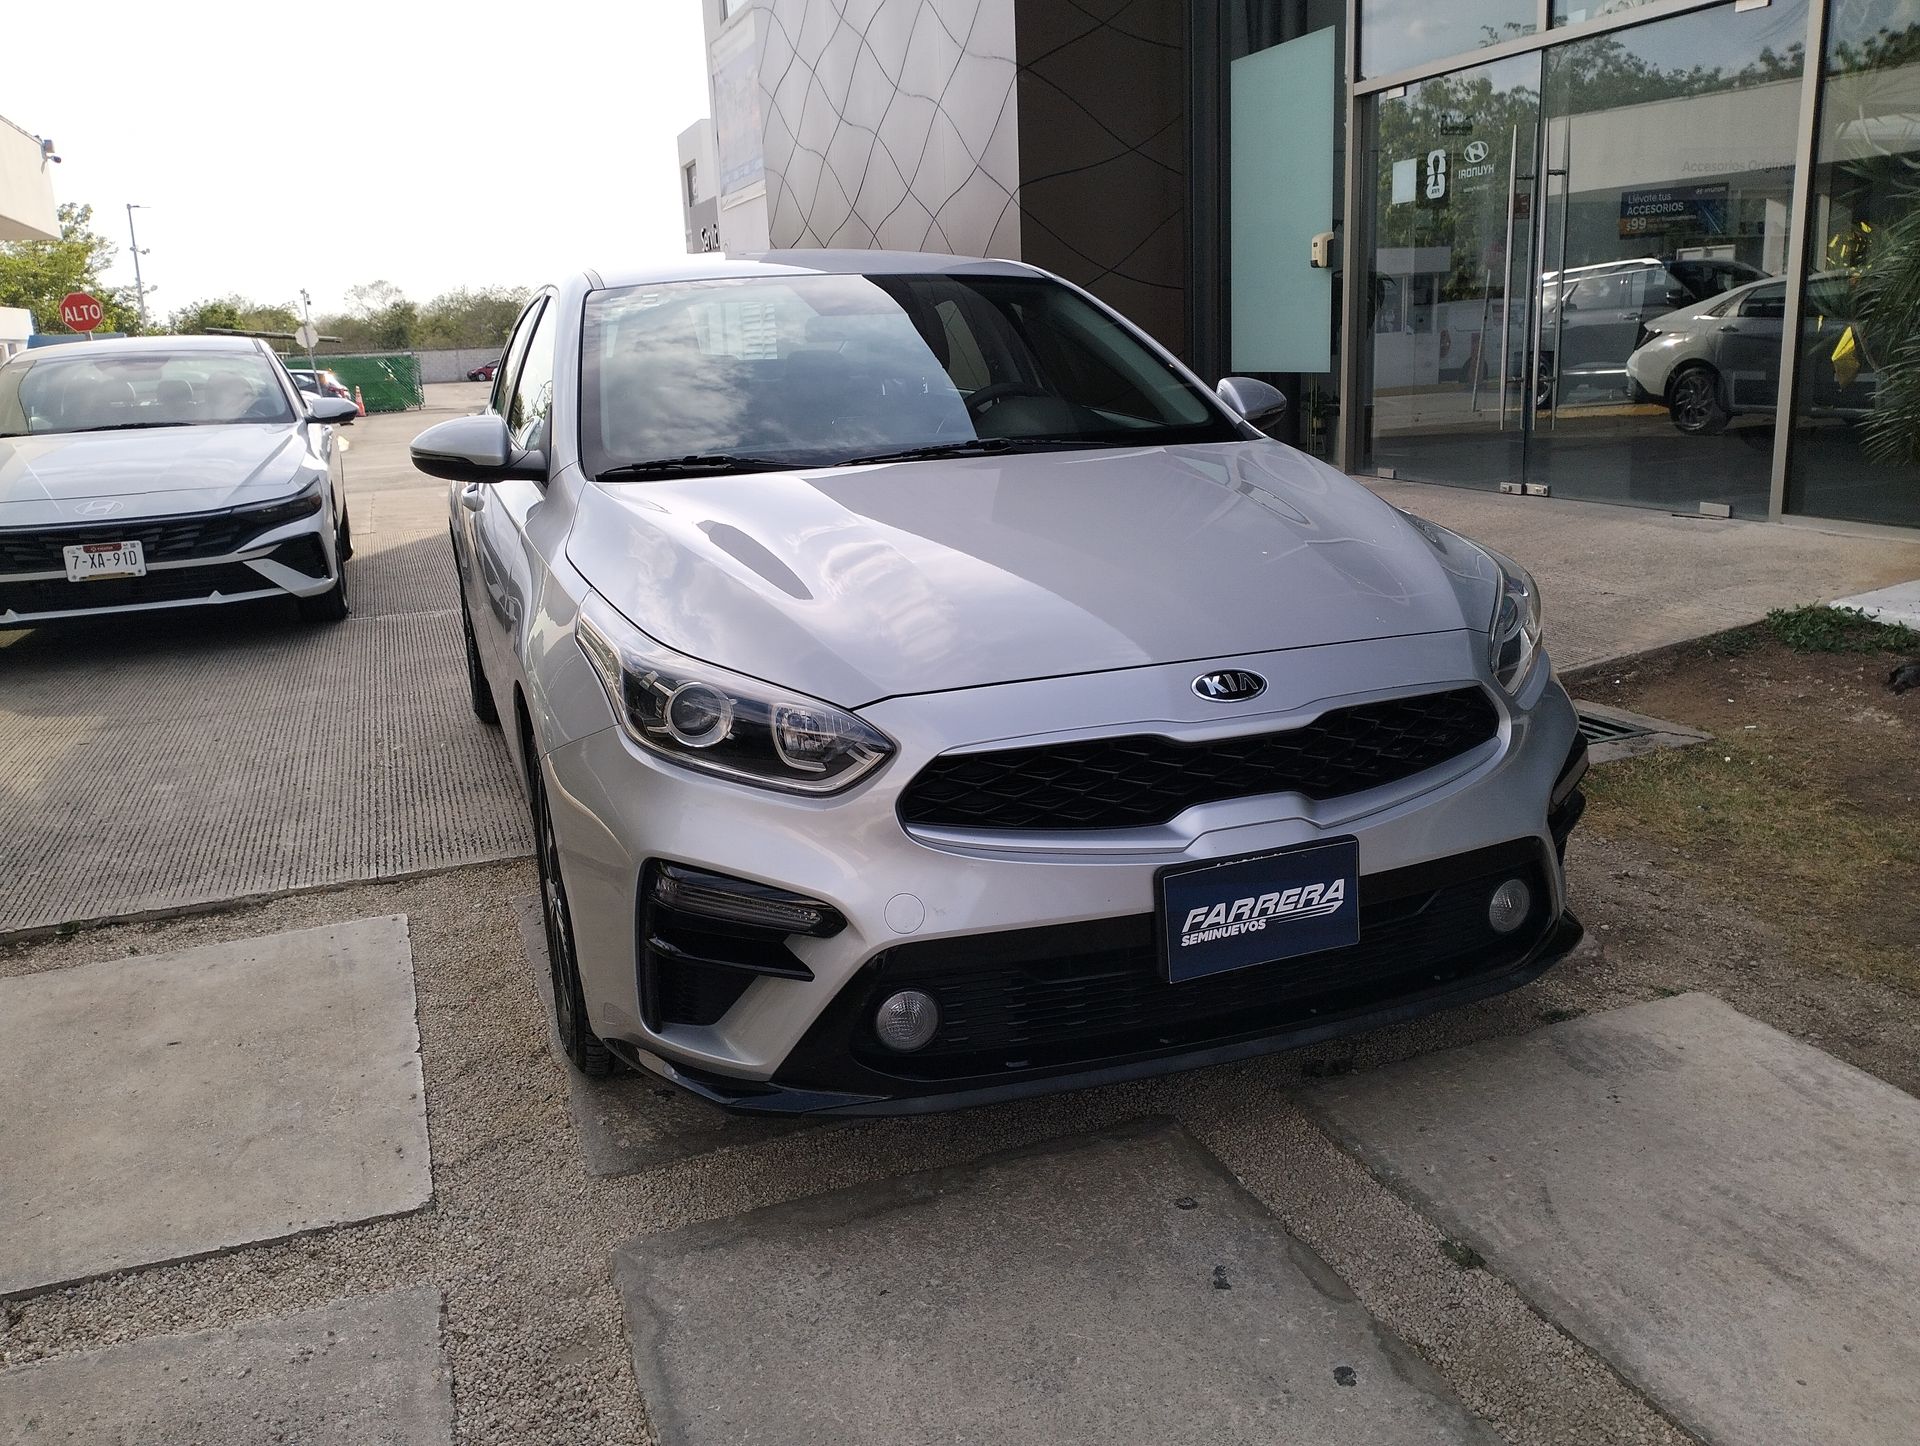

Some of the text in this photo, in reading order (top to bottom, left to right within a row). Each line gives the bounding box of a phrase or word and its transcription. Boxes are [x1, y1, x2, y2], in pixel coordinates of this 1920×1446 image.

[1658, 193, 1672, 202] tus
[1626, 201, 1684, 216] ACCESORIOS
[64, 304, 101, 322] ALTO
[1202, 673, 1259, 696] KIA
[1181, 878, 1345, 934] FARRERA
[1181, 918, 1267, 947] SEMINUEVOS
